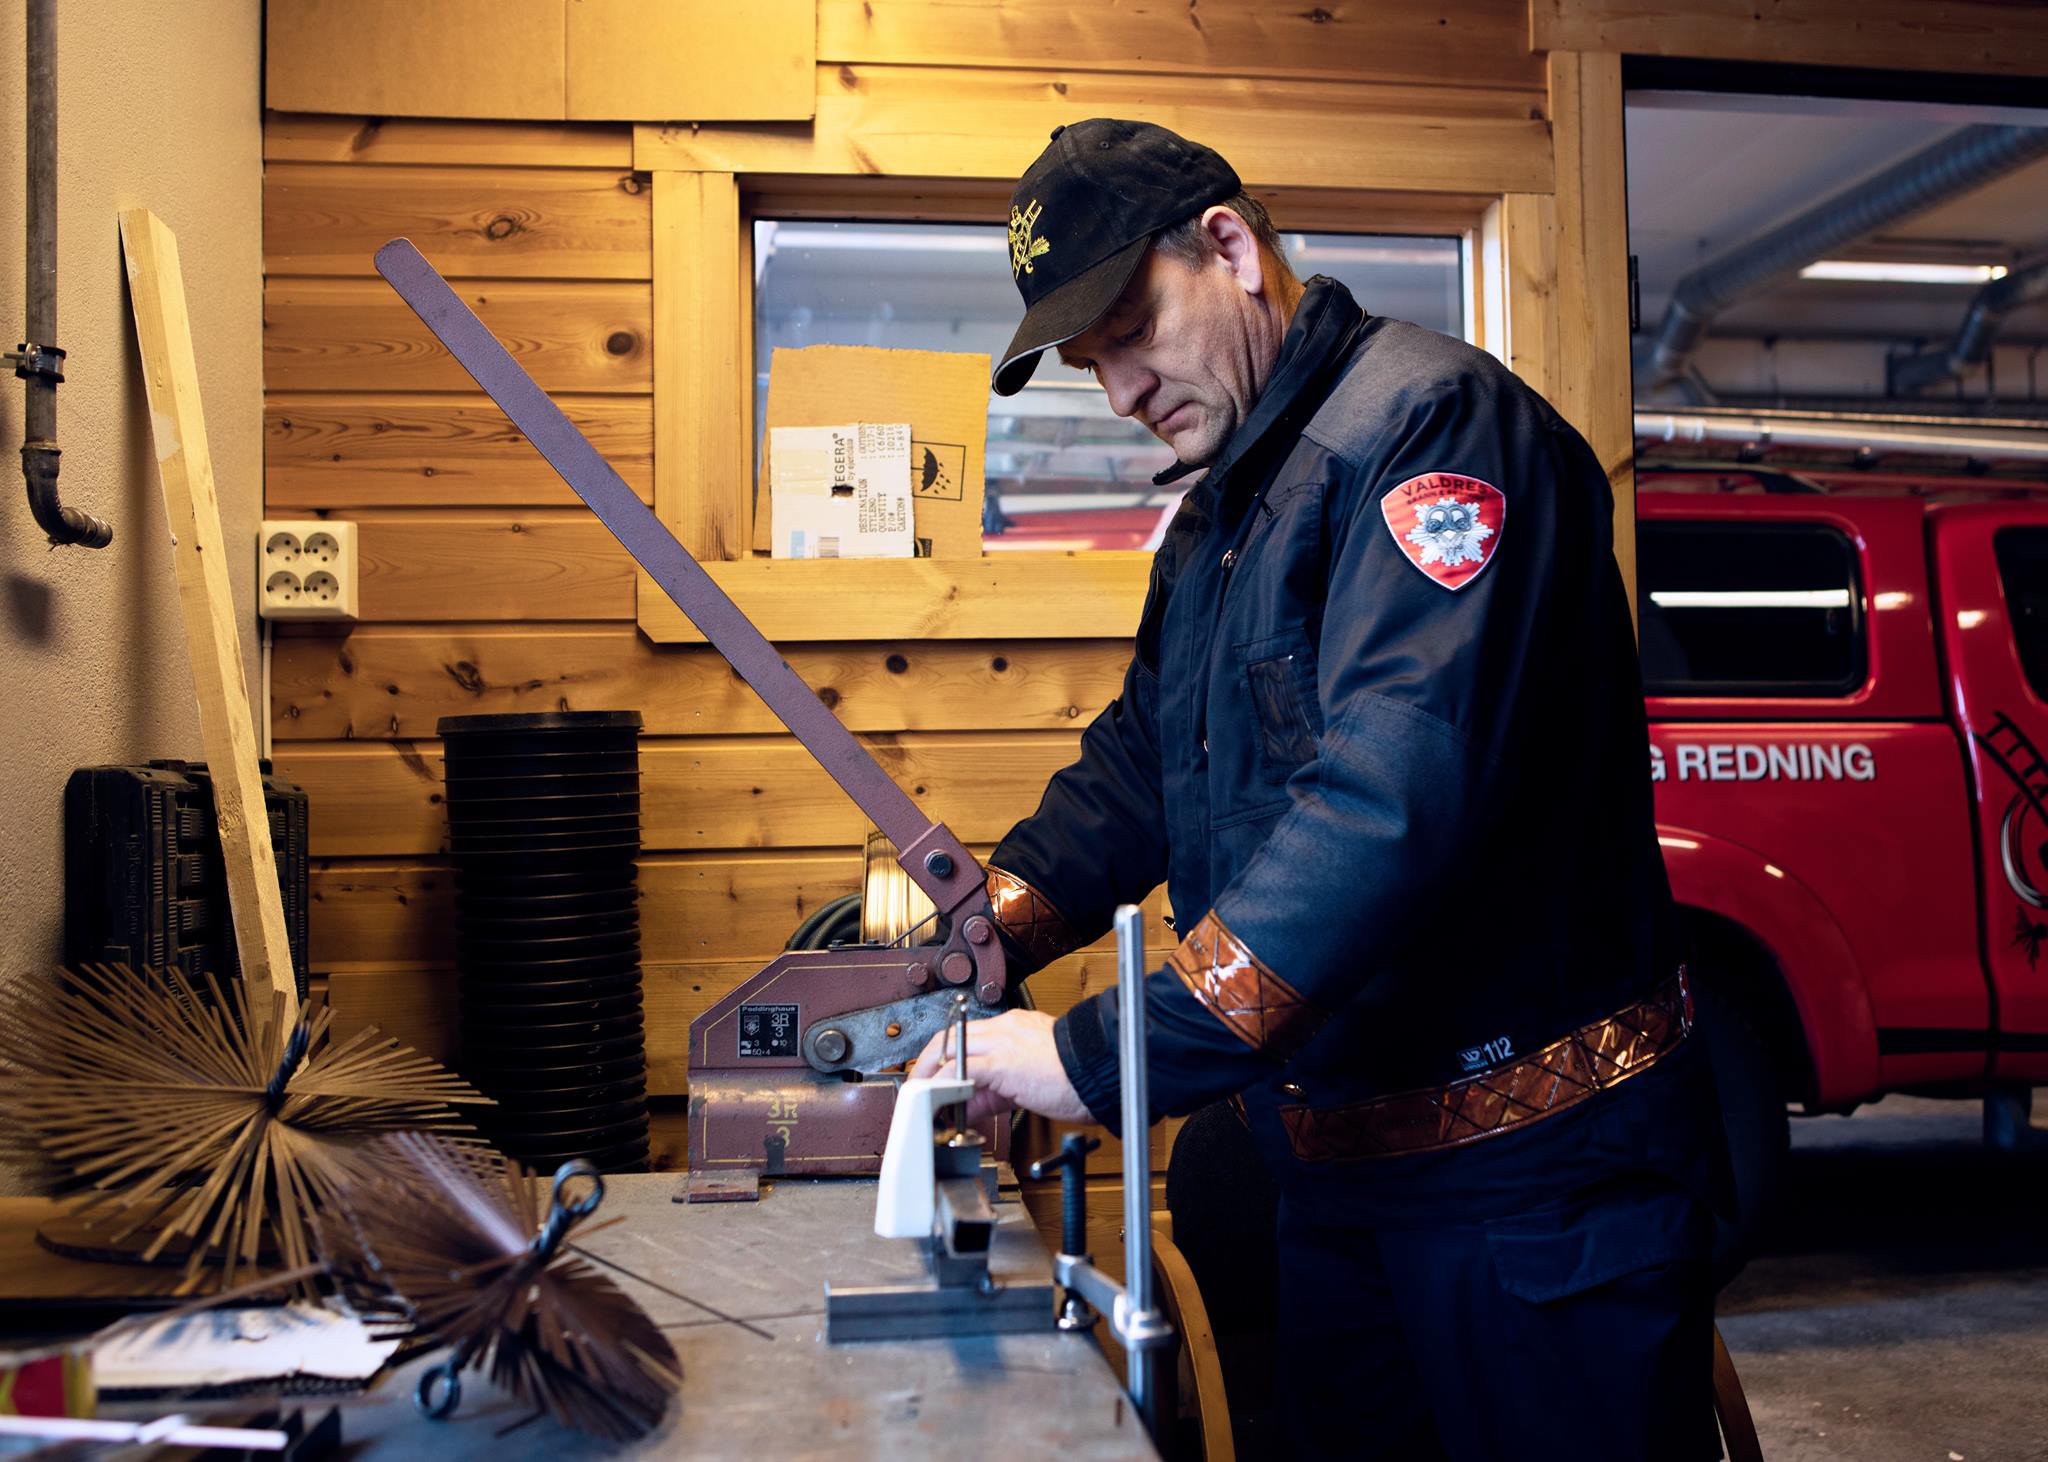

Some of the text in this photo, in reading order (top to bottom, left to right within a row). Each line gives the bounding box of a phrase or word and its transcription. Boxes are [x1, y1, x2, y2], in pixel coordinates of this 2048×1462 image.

[1401, 477, 1488, 496] VALDRES
[859, 478, 868, 533] DESTINATION
[877, 492, 887, 533] QUANTITY
[1676, 743, 1877, 782] REDNING
[771, 1013, 790, 1025] 3R
[775, 1026, 784, 1038] 3
[1483, 1036, 1516, 1063] 112
[767, 1096, 799, 1118] 3R
